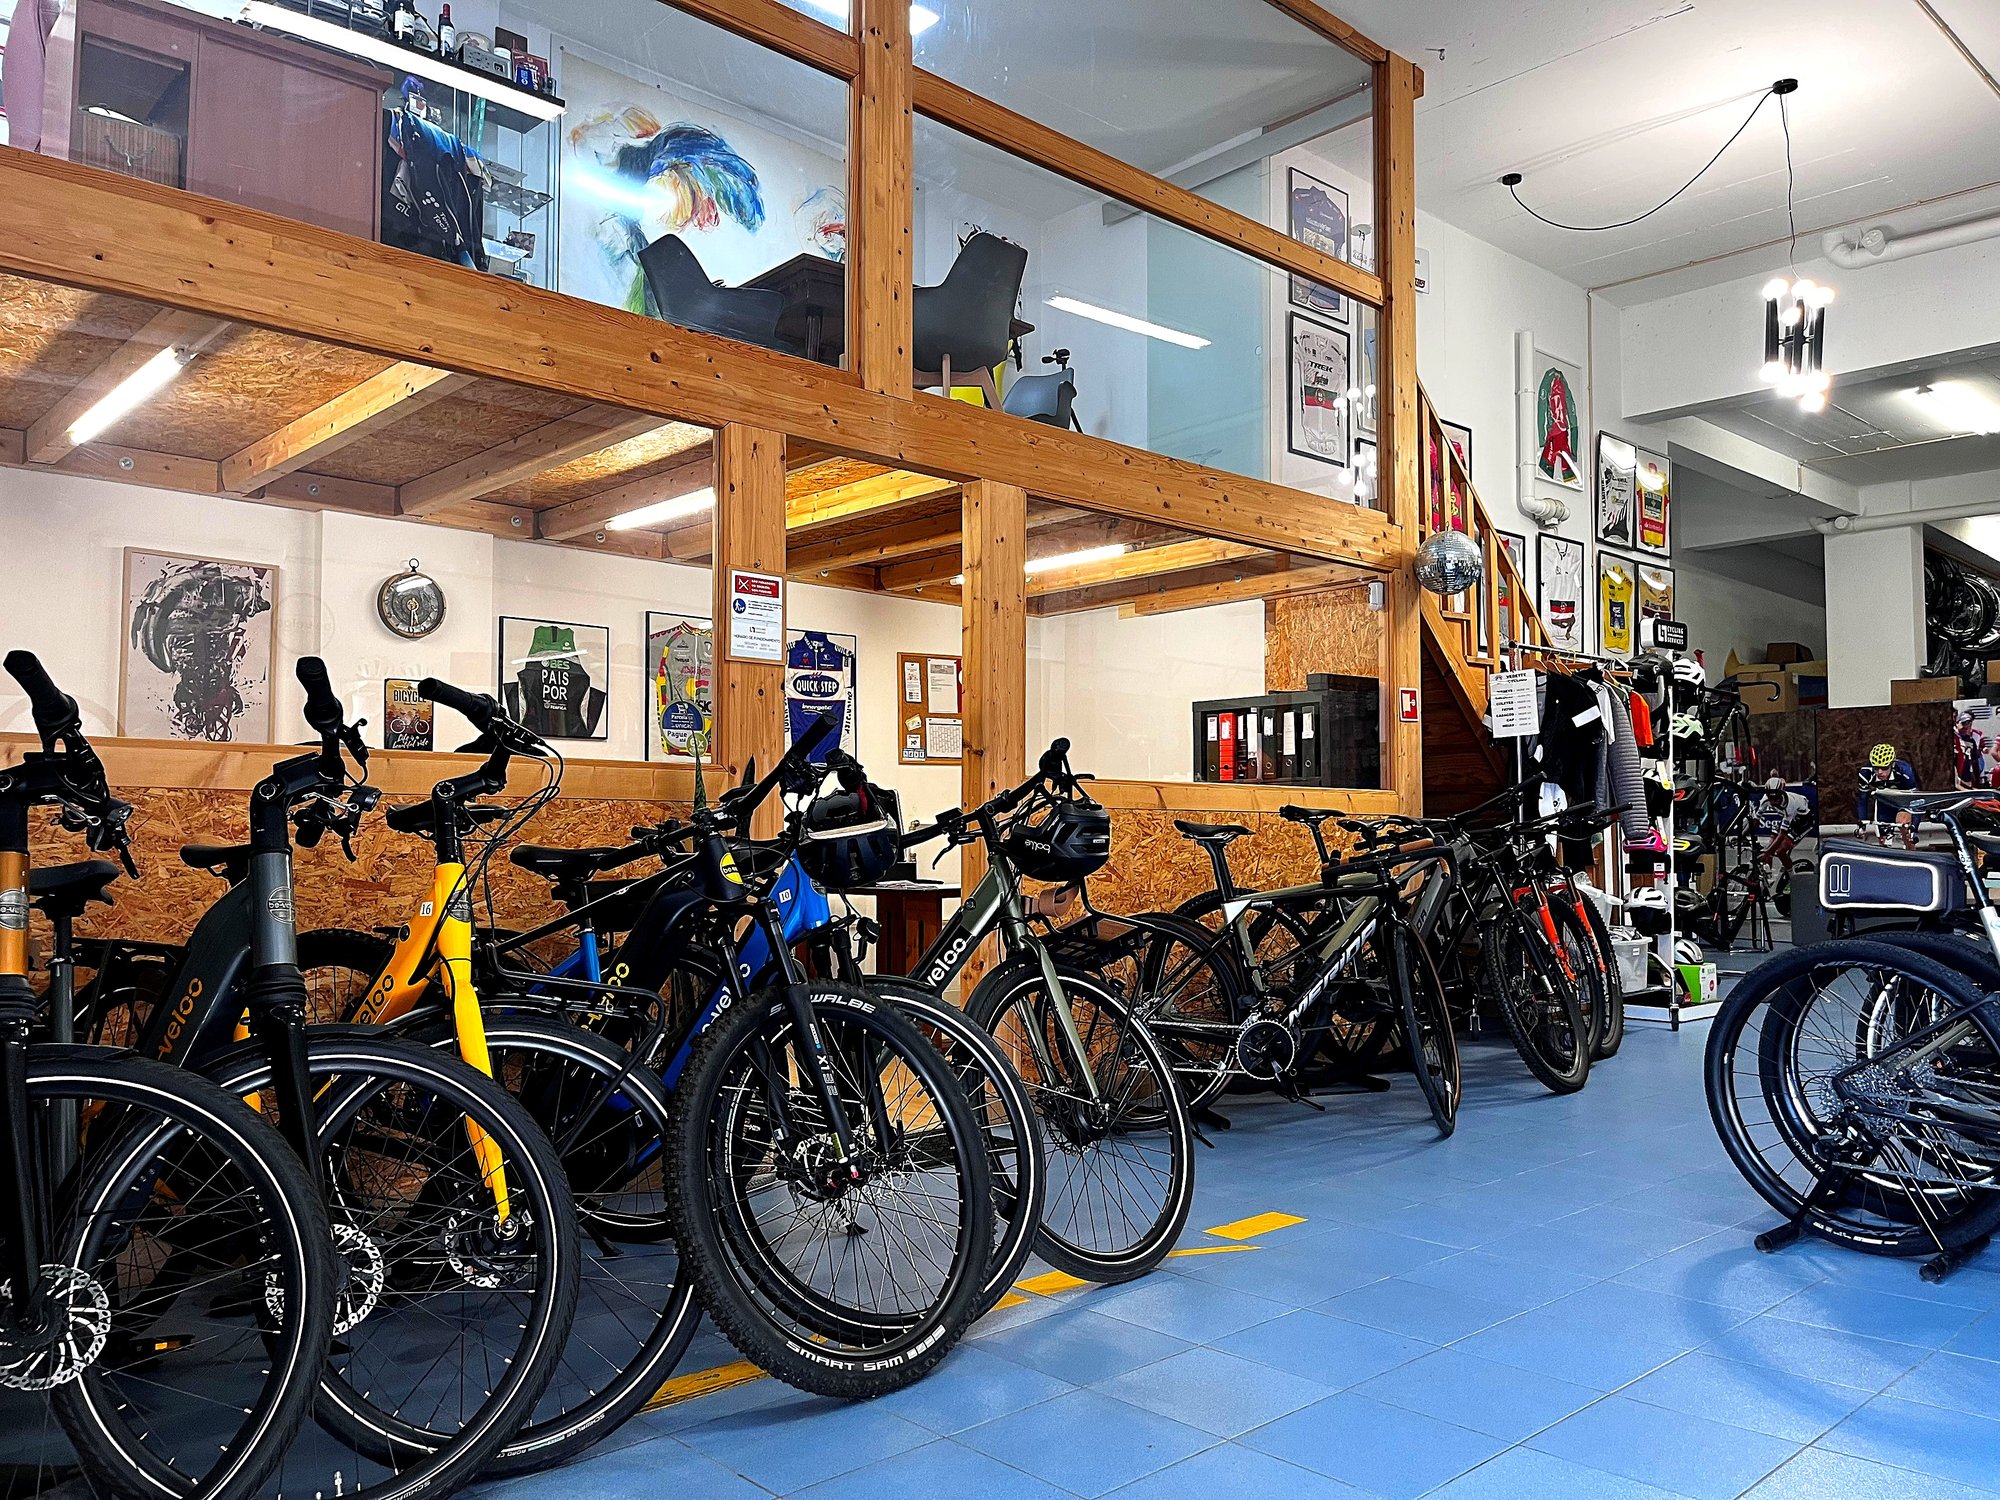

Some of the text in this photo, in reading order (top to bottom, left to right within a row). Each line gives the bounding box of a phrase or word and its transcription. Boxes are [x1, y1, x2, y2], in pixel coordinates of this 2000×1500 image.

[1308, 360, 1333, 373] TREK
[542, 669, 569, 686] PAIS
[542, 684, 568, 701] POR
[667, 731, 688, 739] Pague
[780, 891, 790, 901] 10
[421, 903, 432, 915] 16
[769, 994, 877, 1017] SWALBE
[785, 1340, 904, 1372] SMART SAM
